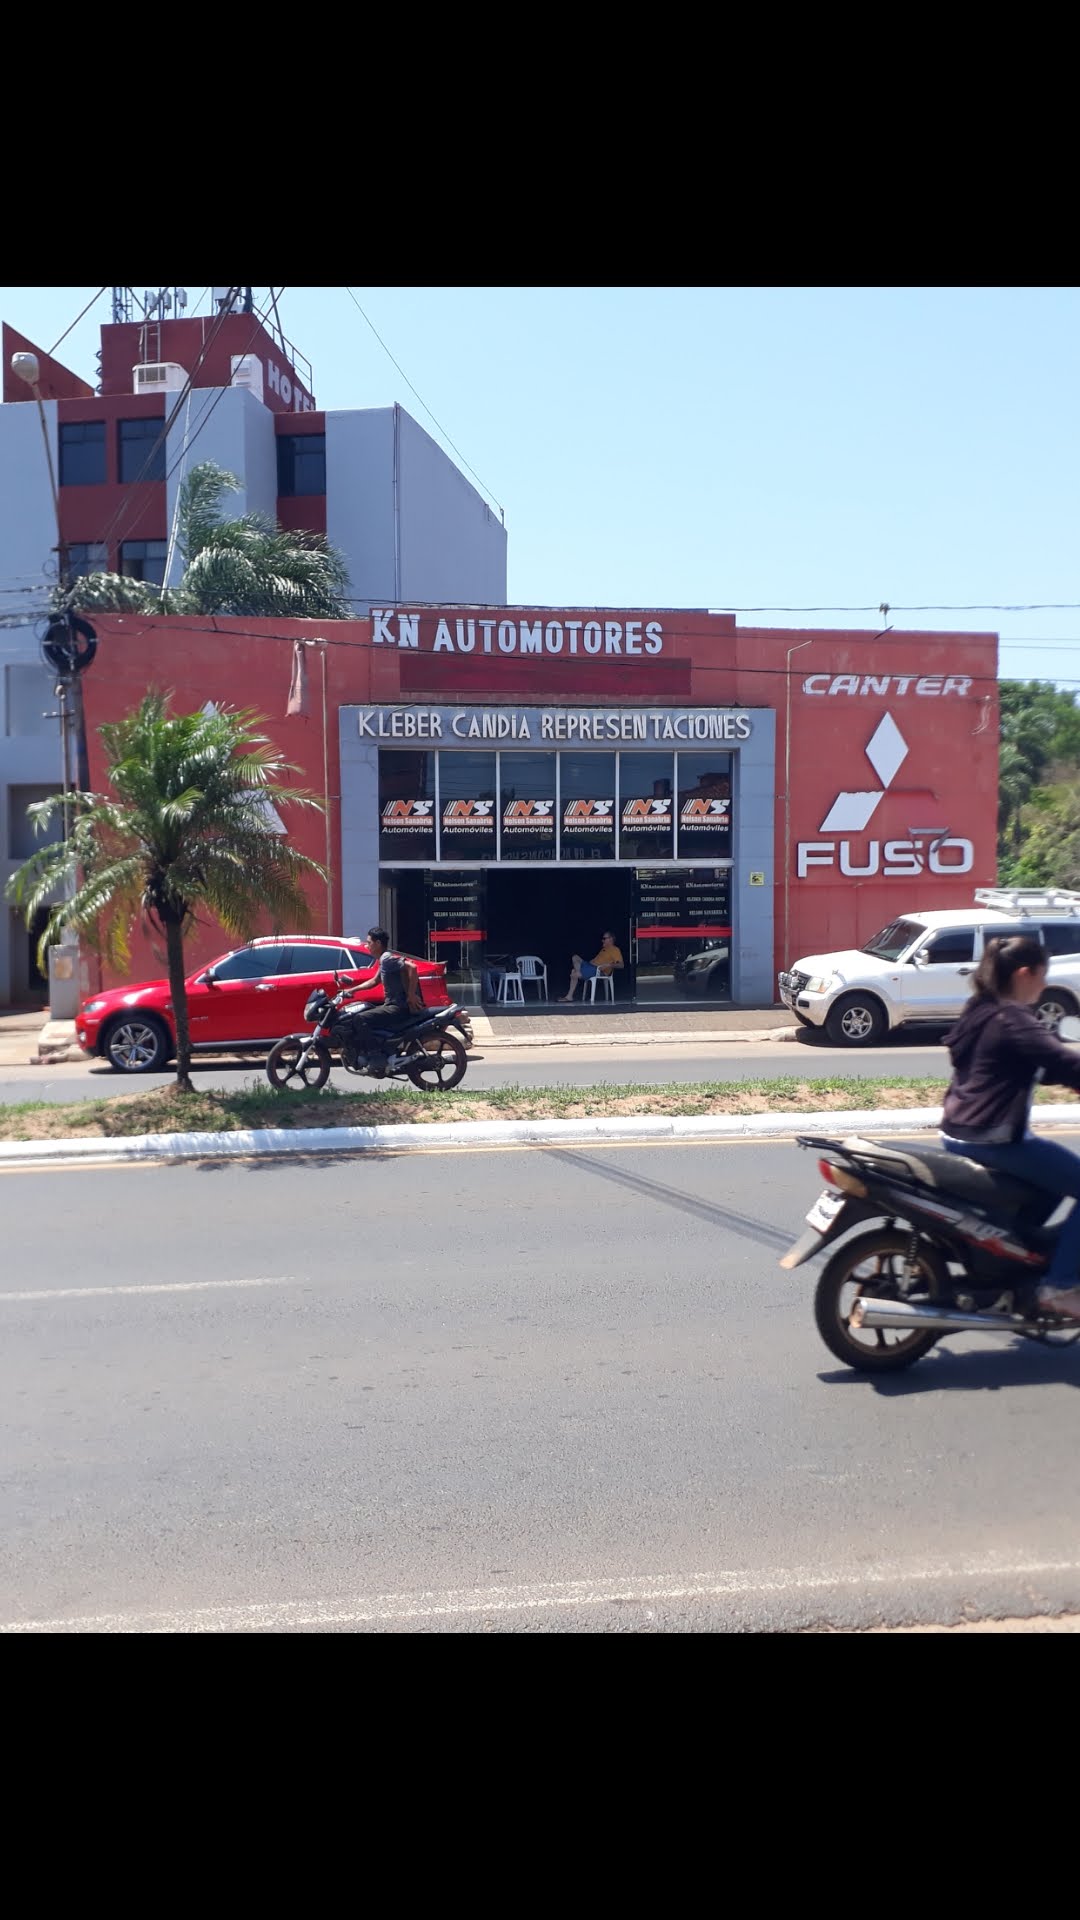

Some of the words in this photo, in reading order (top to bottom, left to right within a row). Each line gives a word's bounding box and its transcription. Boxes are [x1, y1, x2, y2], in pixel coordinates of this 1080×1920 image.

[267, 358, 315, 412] HOTE
[372, 609, 421, 648] KN
[433, 618, 663, 656] AUTOMOTORES
[802, 674, 973, 697] CANTER
[358, 711, 443, 738] KLEBER
[392, 800, 434, 816] NS
[452, 800, 494, 816] NS
[512, 800, 554, 816] NS
[573, 800, 614, 815] NS
[631, 799, 671, 814] NS
[690, 799, 730, 814] NS
[682, 815, 701, 823] Nelson
[702, 815, 728, 823] Sanabria
[563, 825, 613, 833] Automóviles
[622, 824, 671, 832] Automóviles
[680, 823, 729, 832] Automóviles
[797, 837, 975, 878] FUSO
